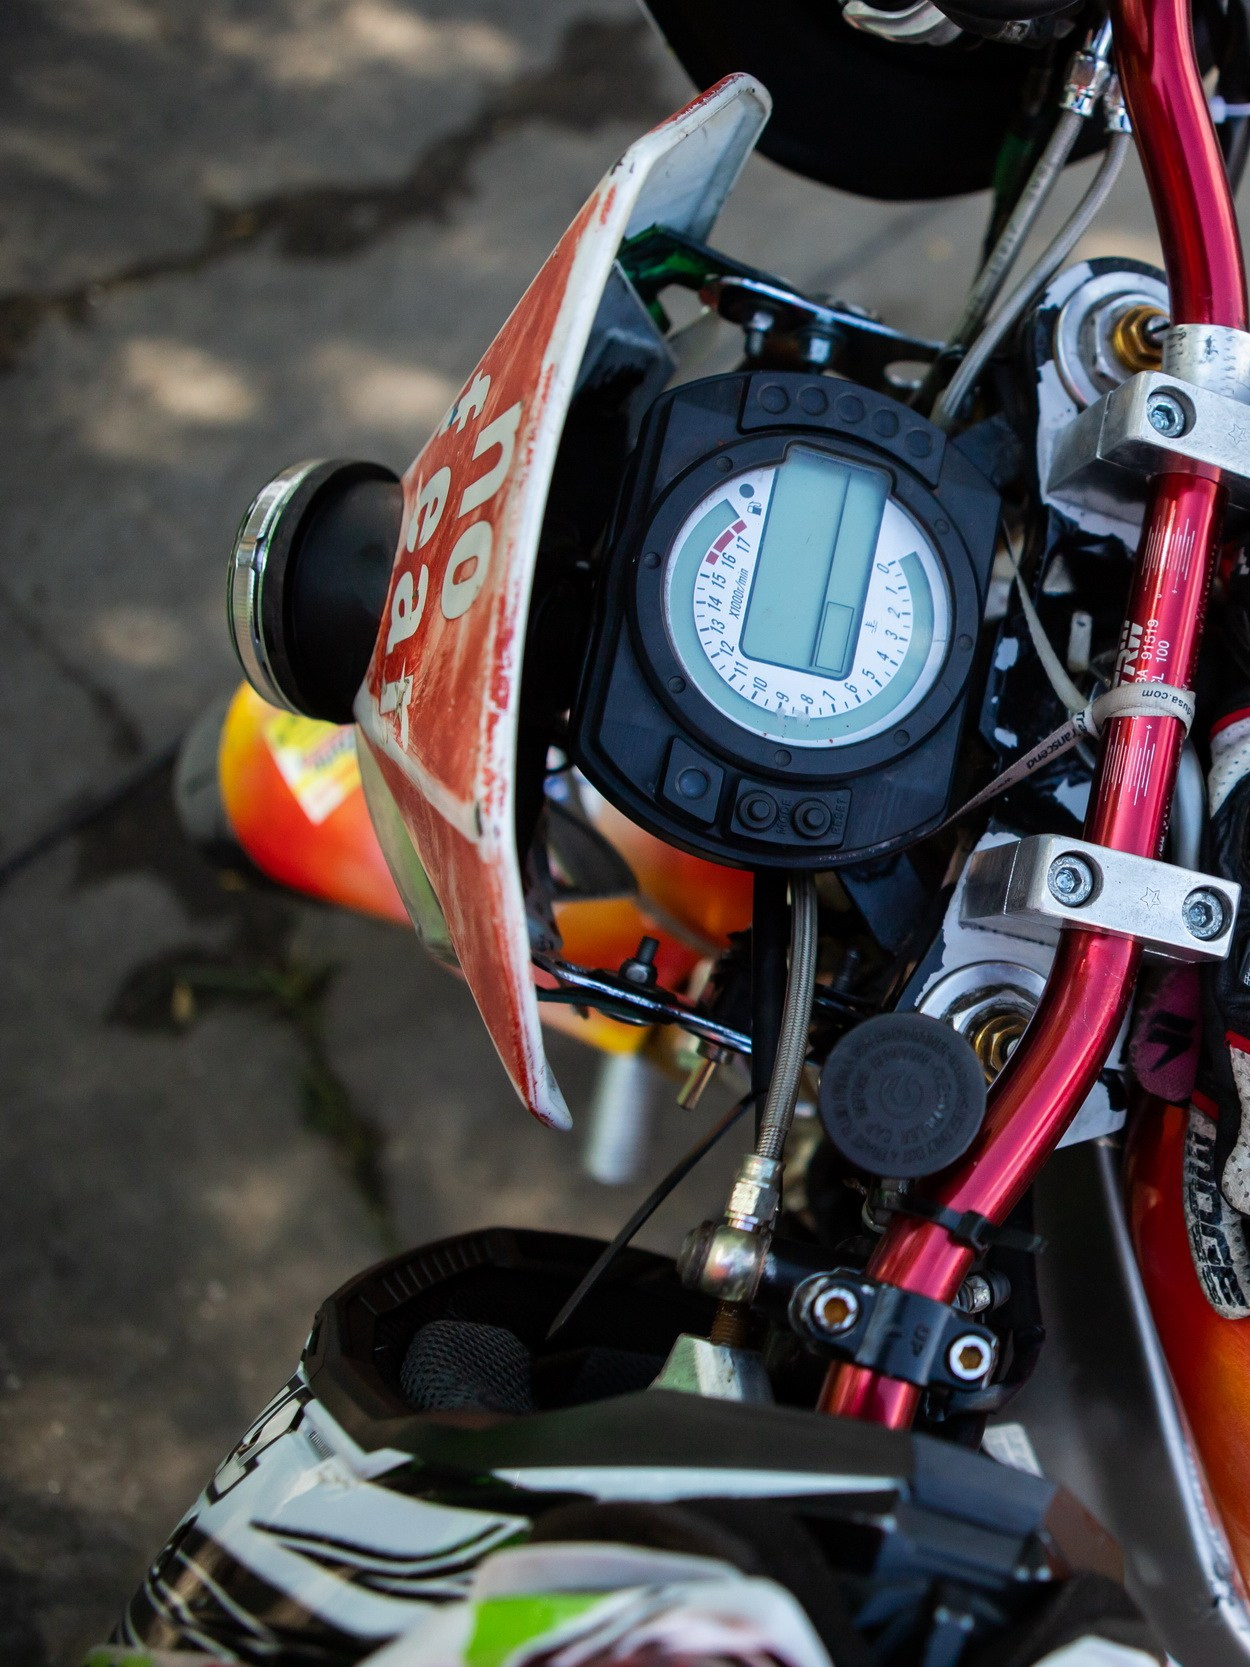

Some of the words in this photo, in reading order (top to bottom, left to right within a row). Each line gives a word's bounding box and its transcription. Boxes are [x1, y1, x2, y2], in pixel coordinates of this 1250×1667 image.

[440, 401, 523, 621] no
[735, 535, 752, 554] 17
[378, 369, 491, 753] fear
[721, 552, 737, 570] 16
[876, 562, 890, 575] 0
[711, 571, 727, 589] 15
[885, 585, 898, 595] 1
[707, 594, 723, 612] 14
[887, 606, 901, 619] 2
[709, 618, 726, 635] 13
[885, 629, 898, 641] 3
[1141, 619, 1159, 660] 91519
[719, 640, 735, 657] 12
[876, 650, 890, 662] 4
[1155, 640, 1170, 663] 100
[734, 660, 749, 676] 11
[862, 668, 876, 680] 5
[752, 676, 768, 692] 10
[844, 682, 858, 694] 6
[775, 691, 790, 703] 9
[800, 694, 814, 705] 8
[822, 690, 836, 702] 7
[775, 798, 792, 835] MODE
[831, 797, 848, 836] RESET
